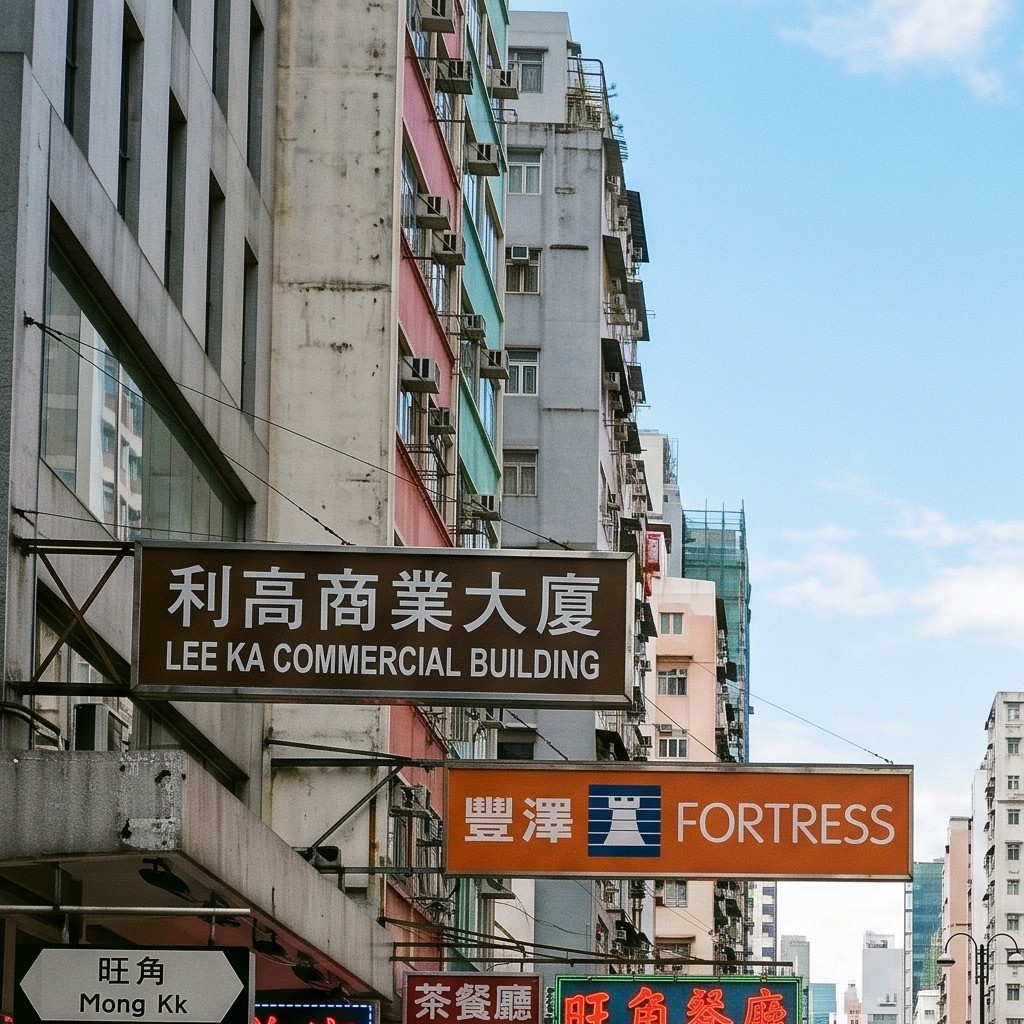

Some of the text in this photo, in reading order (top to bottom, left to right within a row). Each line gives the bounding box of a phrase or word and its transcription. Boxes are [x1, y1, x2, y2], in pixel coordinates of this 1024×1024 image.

[167, 564, 600, 637] 利高商業大廈
[166, 641, 600, 680] LEE KA COMMERCIAL BUILDING
[464, 797, 896, 845] 豐澤 FORTRESS
[99, 956, 165, 986] 旺角
[80, 994, 188, 1017] Mong Kk
[415, 982, 532, 1021] 茶餐廳
